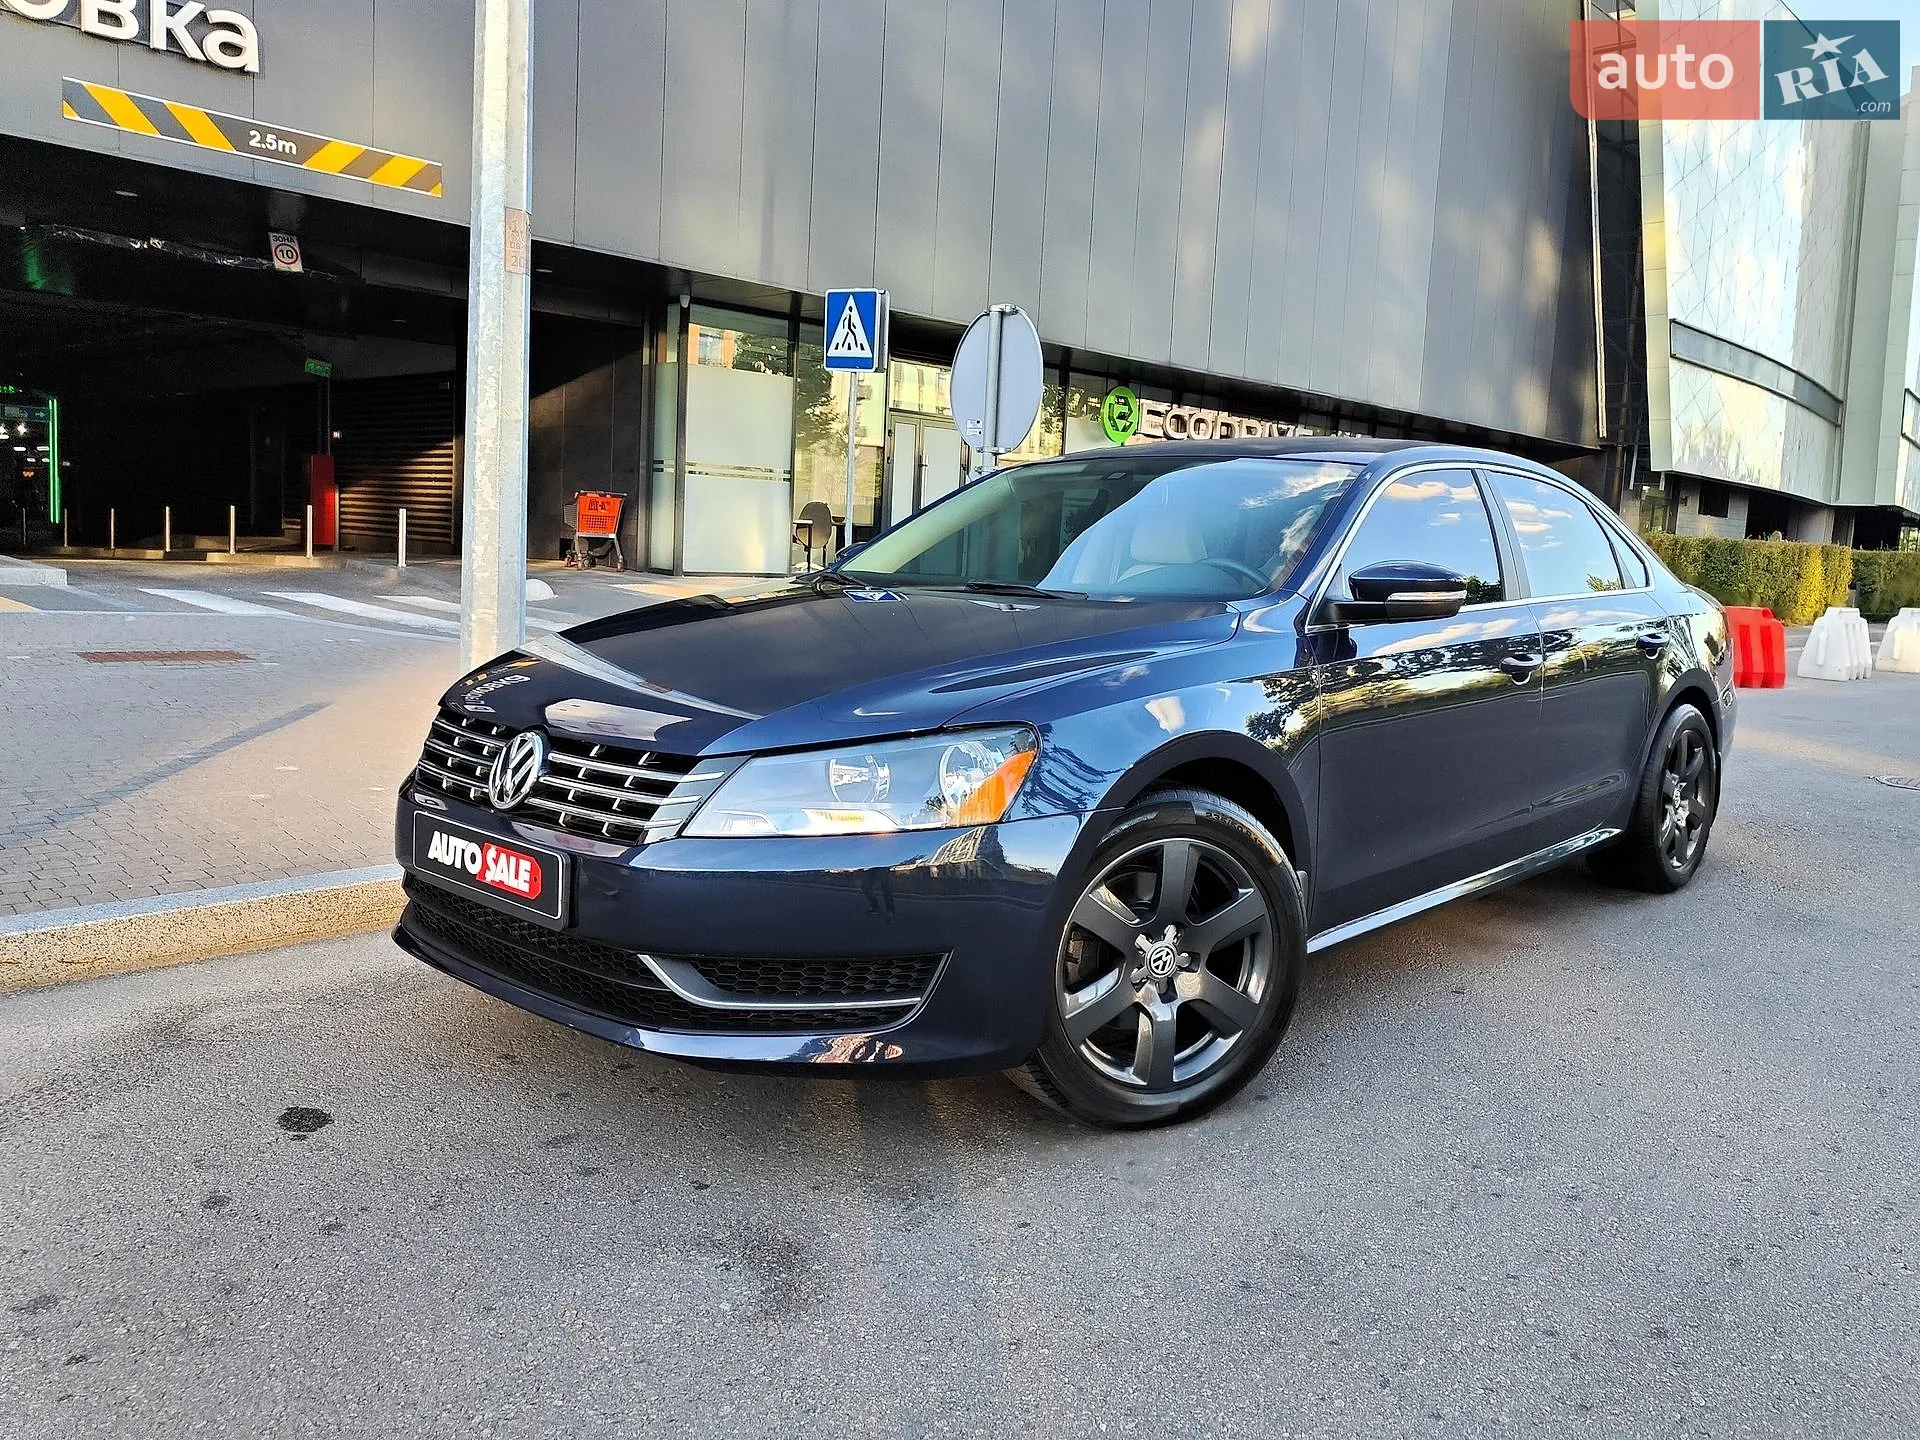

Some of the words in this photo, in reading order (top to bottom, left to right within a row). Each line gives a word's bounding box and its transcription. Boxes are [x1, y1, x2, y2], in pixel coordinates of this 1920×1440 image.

[249, 130, 297, 155] 2.5m
[272, 234, 296, 244] ЗОНА
[279, 249, 294, 260] 10
[427, 830, 482, 875] AUTO
